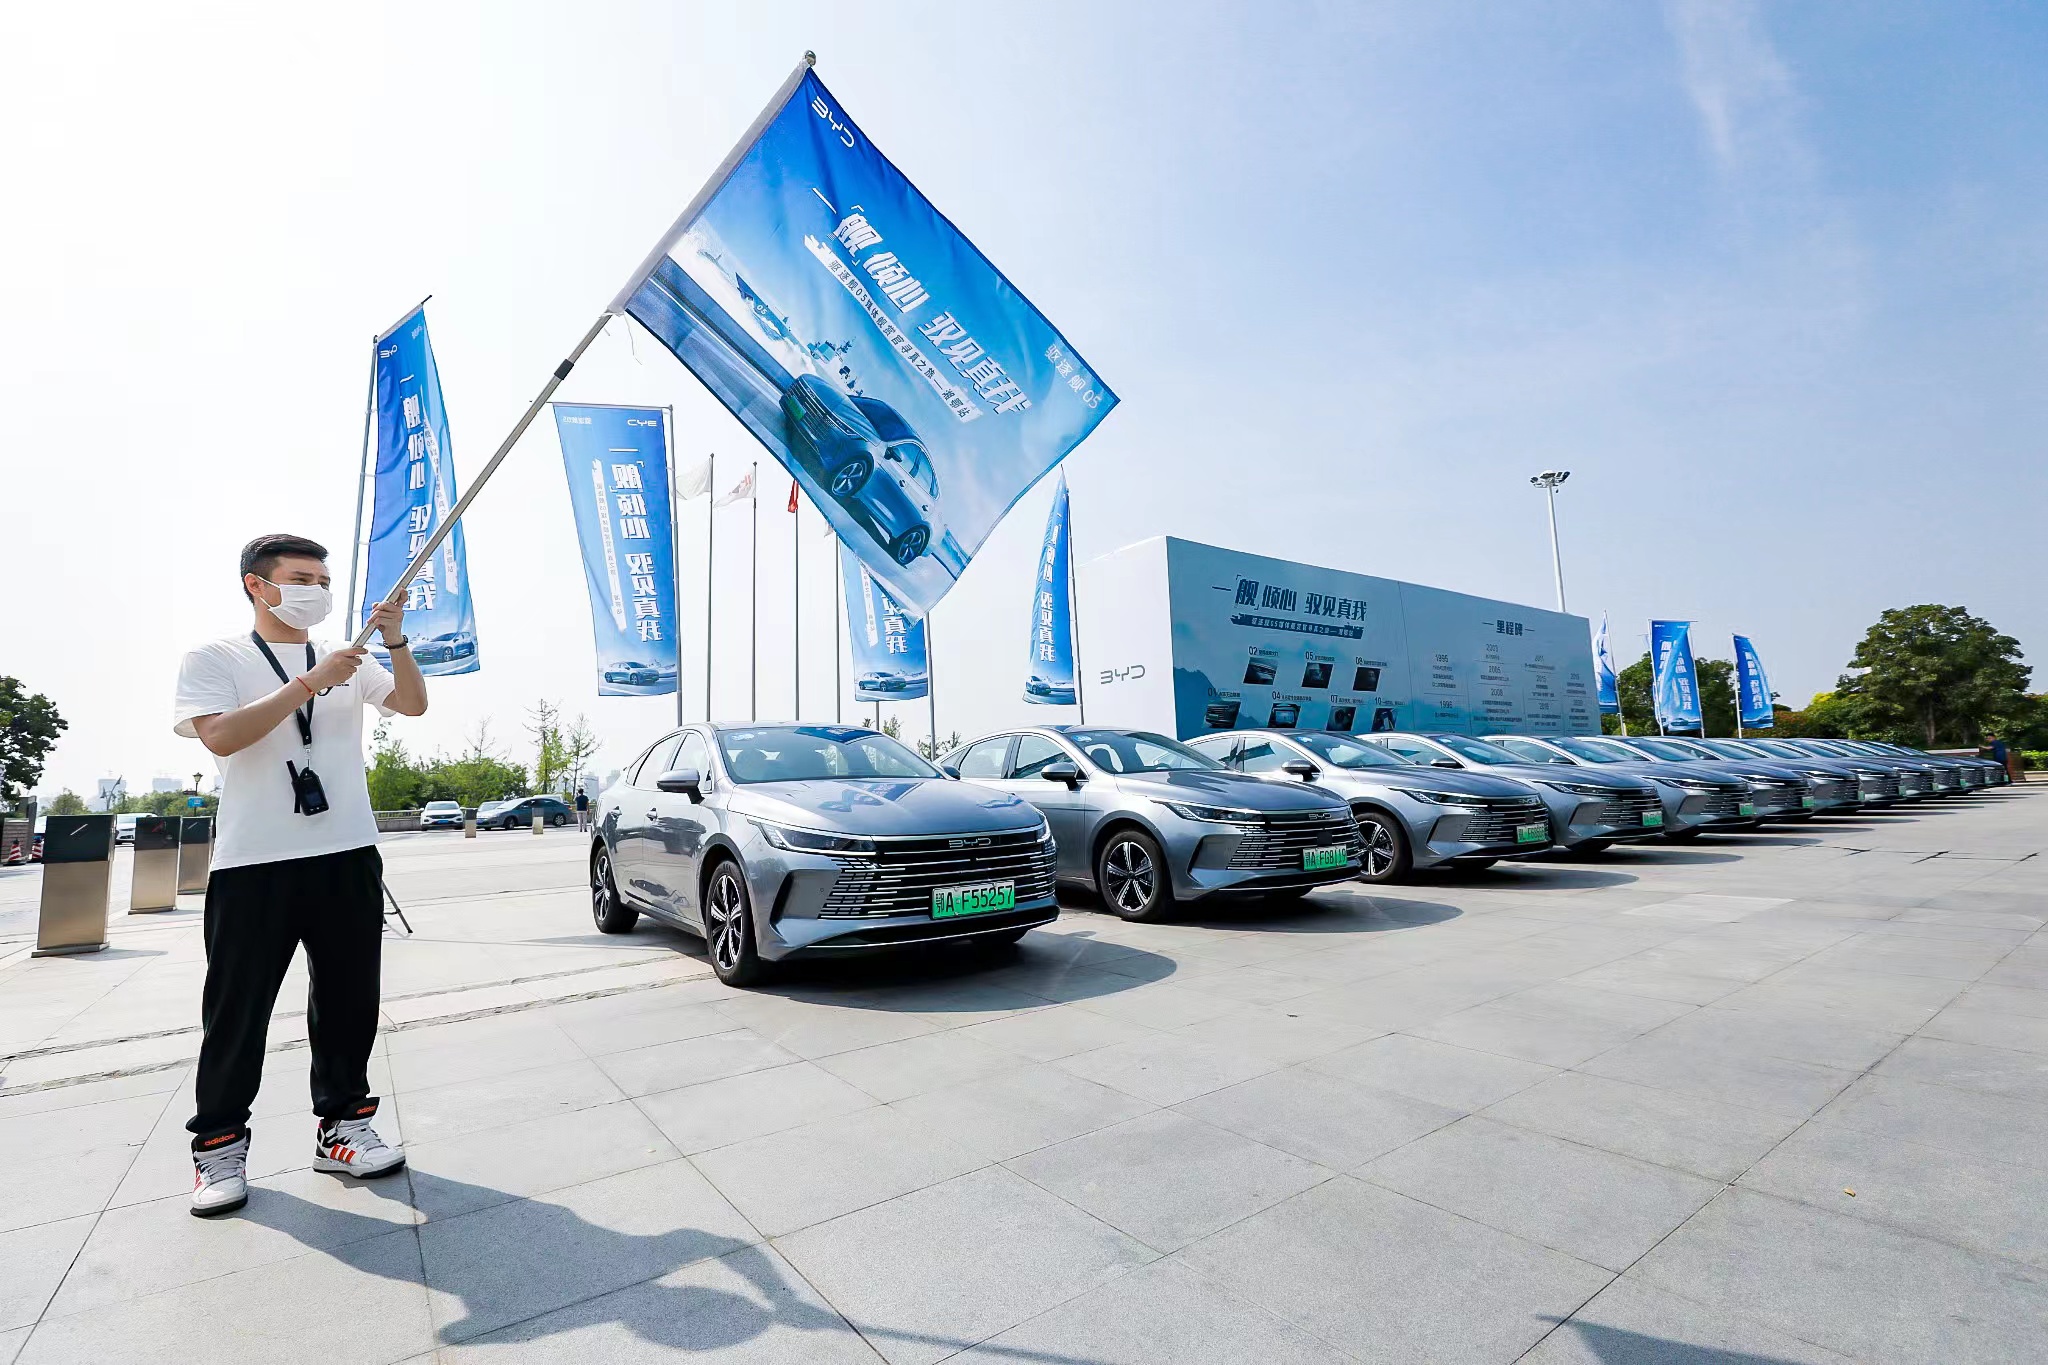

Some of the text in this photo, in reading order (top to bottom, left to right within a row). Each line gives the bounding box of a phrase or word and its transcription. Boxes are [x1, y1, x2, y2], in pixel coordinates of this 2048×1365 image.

[811, 95, 855, 148] BYD
[917, 311, 1032, 417] 驭见真我
[1304, 592, 1368, 621] 驭见真我
[1248, 646, 1258, 656] 02
[1305, 651, 1314, 661] 05
[1100, 664, 1146, 685] BYD
[1272, 691, 1281, 700] 04
[1308, 812, 1332, 820] BYD
[948, 837, 992, 849] BYD
[356, 1105, 377, 1115] adidas
[204, 1133, 236, 1147] adidas
